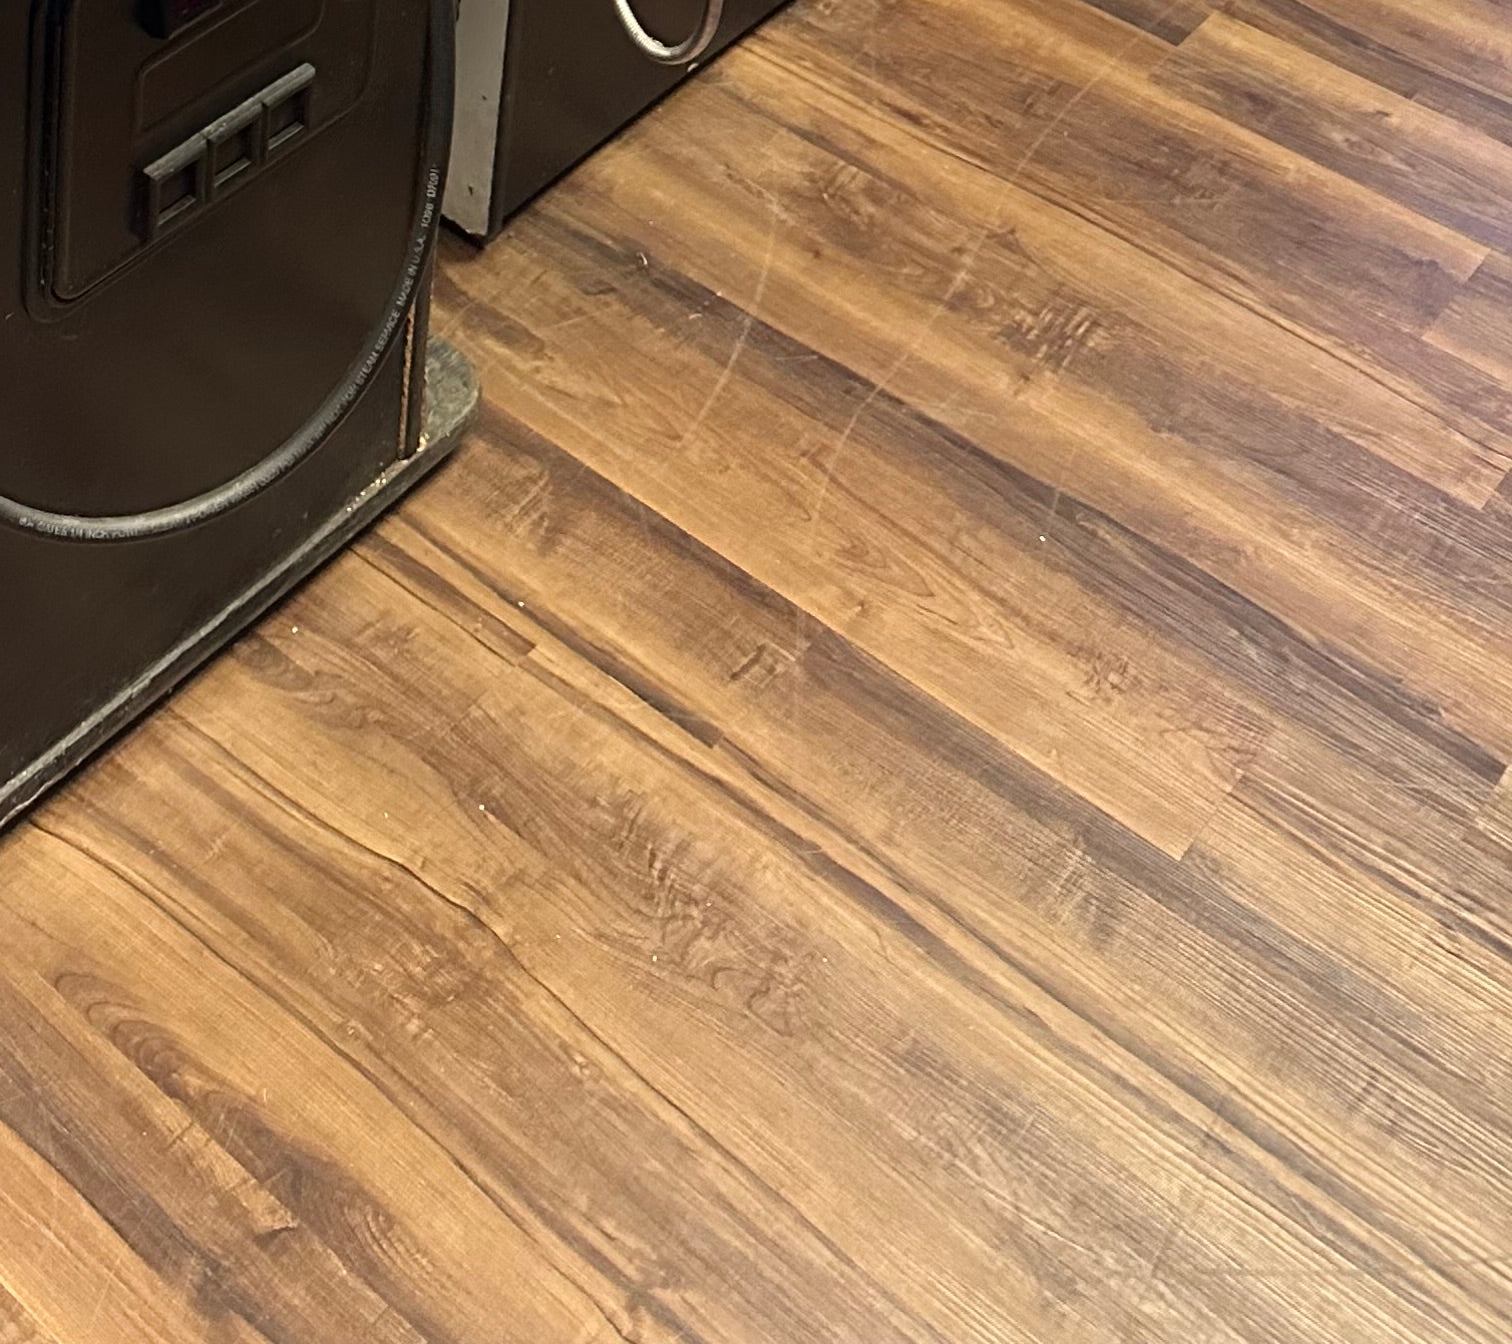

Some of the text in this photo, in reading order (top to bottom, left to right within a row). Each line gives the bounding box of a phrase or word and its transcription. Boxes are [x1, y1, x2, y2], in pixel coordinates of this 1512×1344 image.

[375, 311, 402, 353] SERVICE
[396, 275, 414, 307] MADE
[407, 261, 421, 277] IN
